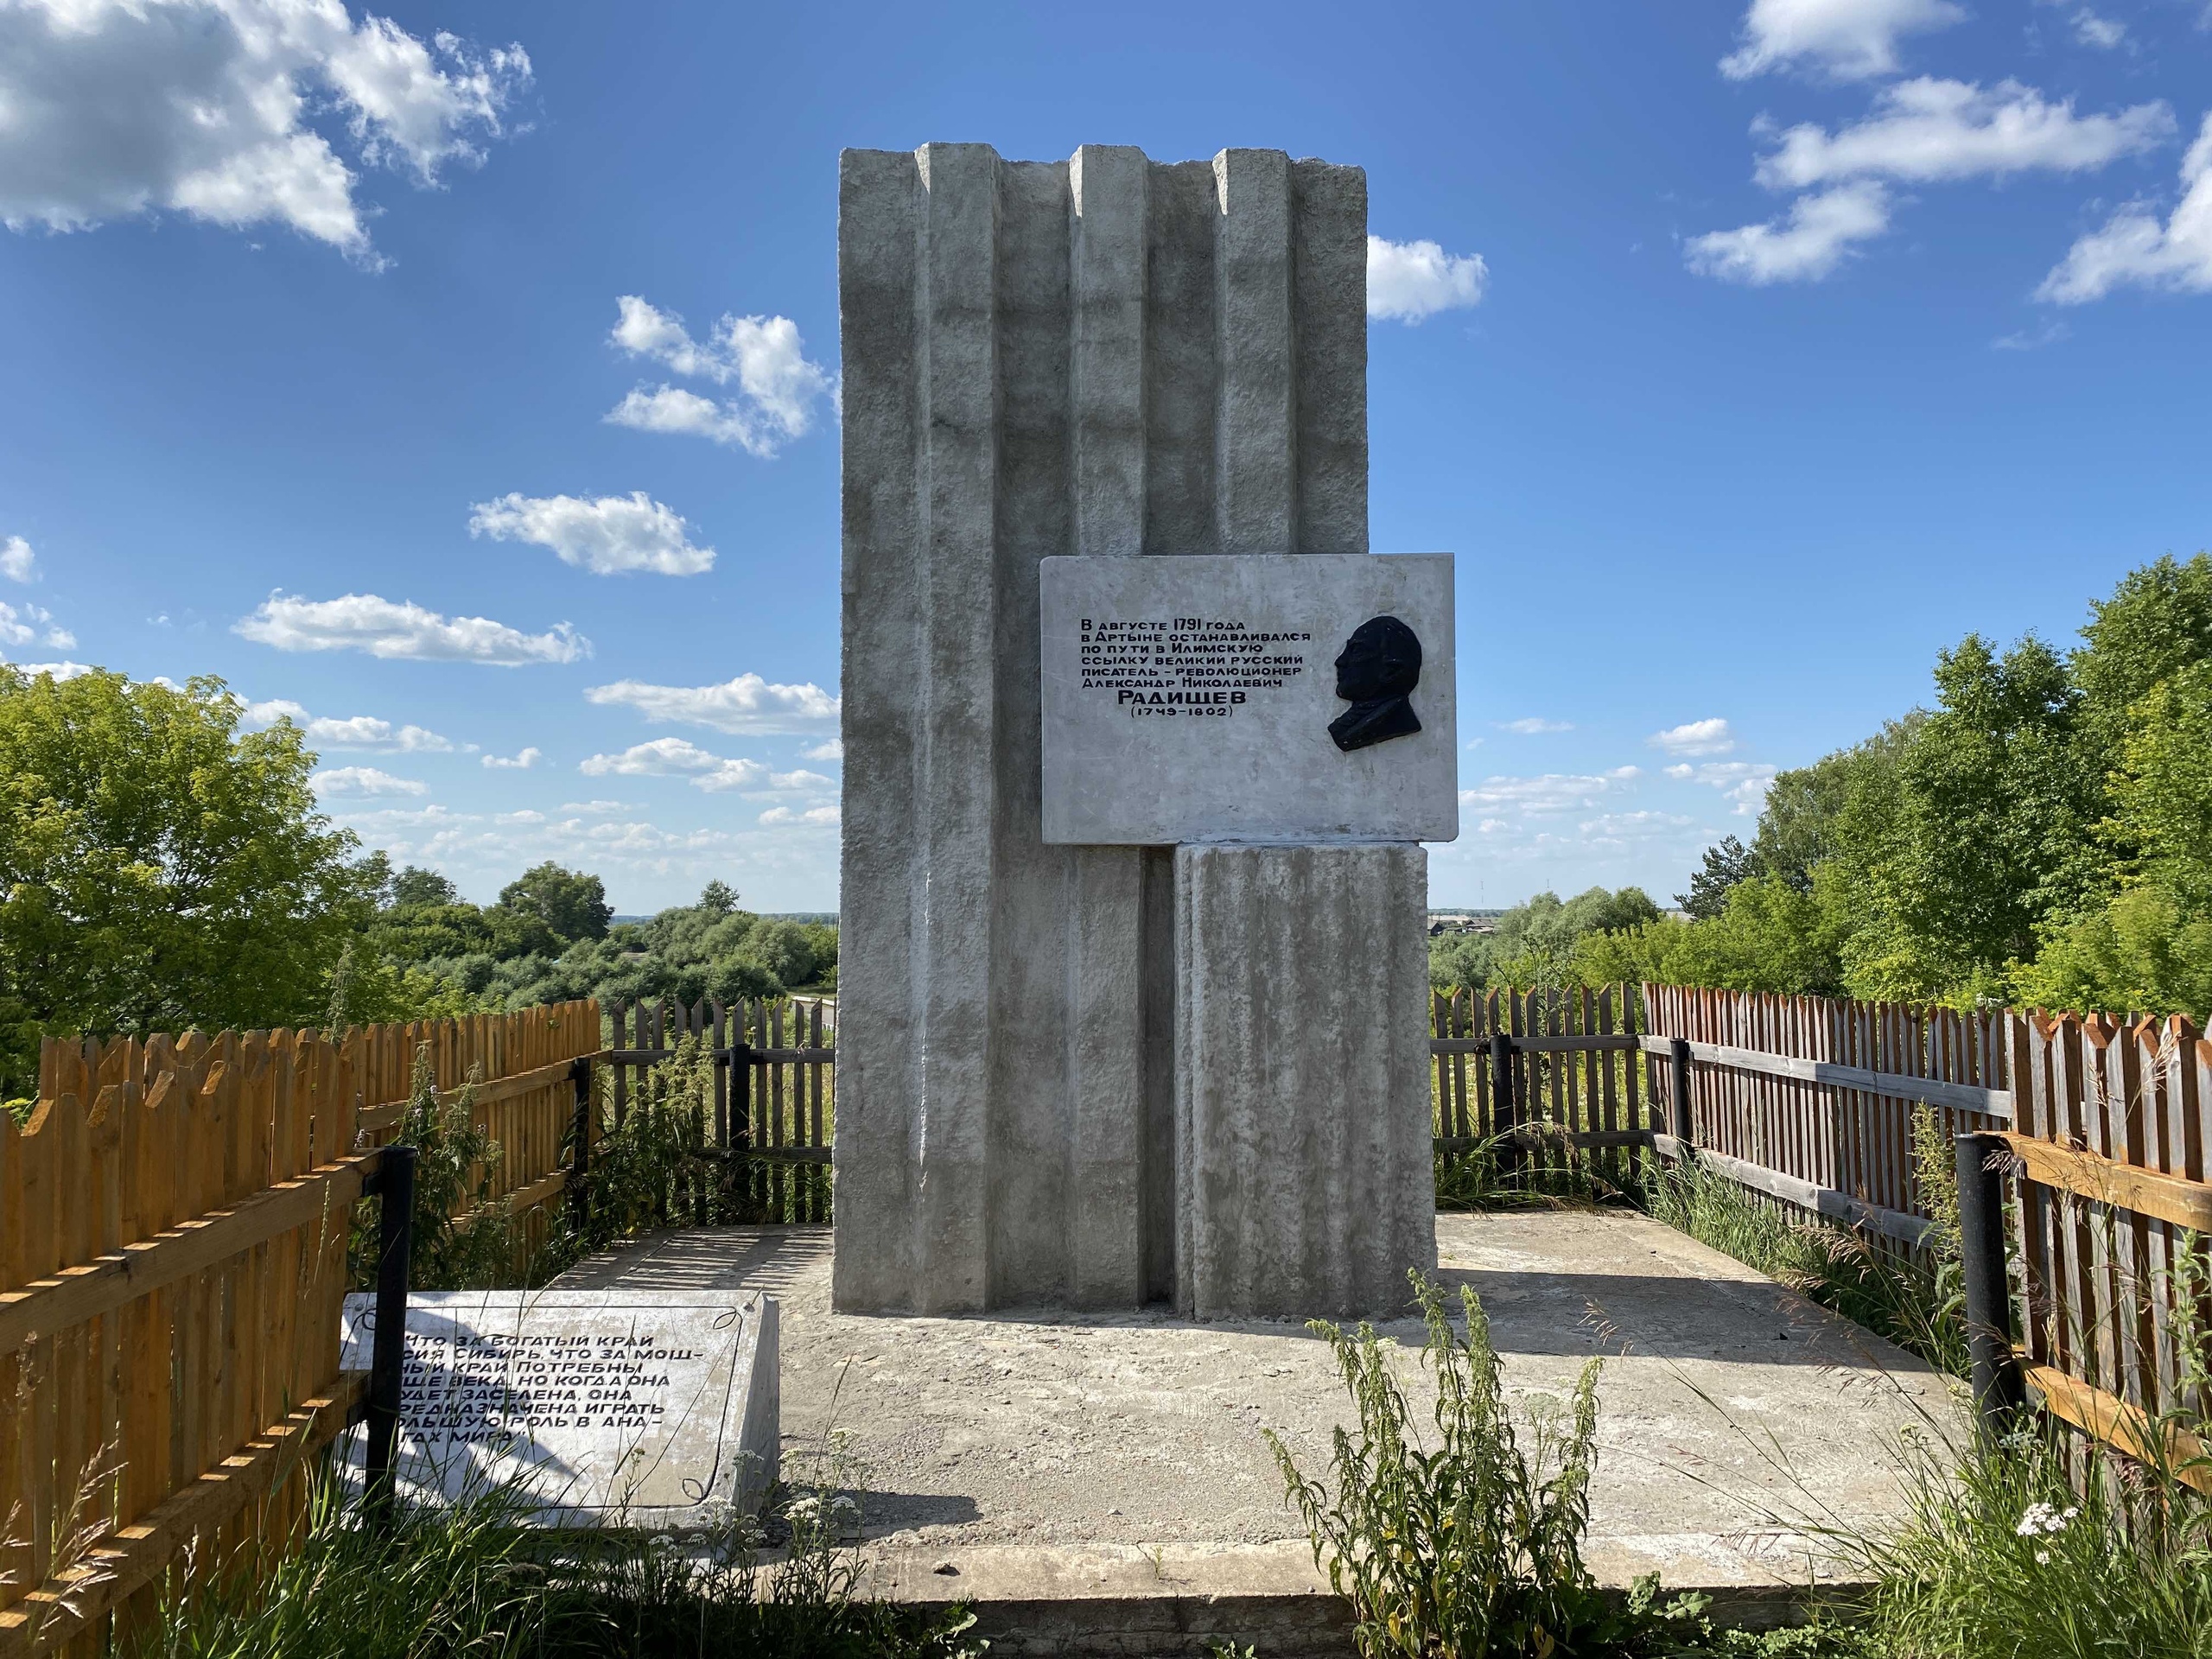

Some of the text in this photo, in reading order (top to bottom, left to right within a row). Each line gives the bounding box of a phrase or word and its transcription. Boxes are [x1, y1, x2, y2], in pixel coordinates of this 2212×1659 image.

[1081, 618, 1245, 631] В АВГУСТЕ 1791 ГОДА
[1081, 632, 1311, 643] В АРТЫНЕ ОСТАНАВЛИВАЛСЯ
[1081, 642, 1263, 654] ПО ПУТИ В ИЛИМСКУЮ
[1081, 653, 1303, 665] ССЫЛКУ ВЕЛИКИЙ РУССКИЙ
[1081, 668, 1158, 677] ПИСАТЕЛЬ
[1175, 667, 1301, 677] РЕВОЛЮЦИОНЕР
[1082, 677, 1282, 689] АЛЕКСАНДР НИКОЛАЕВИЧ
[1130, 705, 1233, 718] (1749-1802)
[406, 1335, 654, 1347] ЧТО ЗА БОГАТЫЙ КРАЙ
[403, 1350, 445, 1360] СИЯ
[550, 1349, 592, 1360] ЧТО
[600, 1349, 625, 1360] ЗА
[516, 1361, 643, 1373] ПОТРЕБНЫ
[403, 1376, 442, 1387] ЩЕ
[518, 1375, 548, 1386] НО
[555, 1375, 621, 1386] КОГДА
[627, 1374, 670, 1387] ОНА
[400, 1389, 457, 1401] УДЕТ
[588, 1389, 632, 1401] ОНА
[399, 1403, 665, 1414] РЕДНАЗНАЧЕНА ИГРАТЬ
[398, 1416, 501, 1428] ОЛЬШУЮ
[510, 1416, 568, 1427] РОЛЬ
[575, 1416, 590, 1427] В
